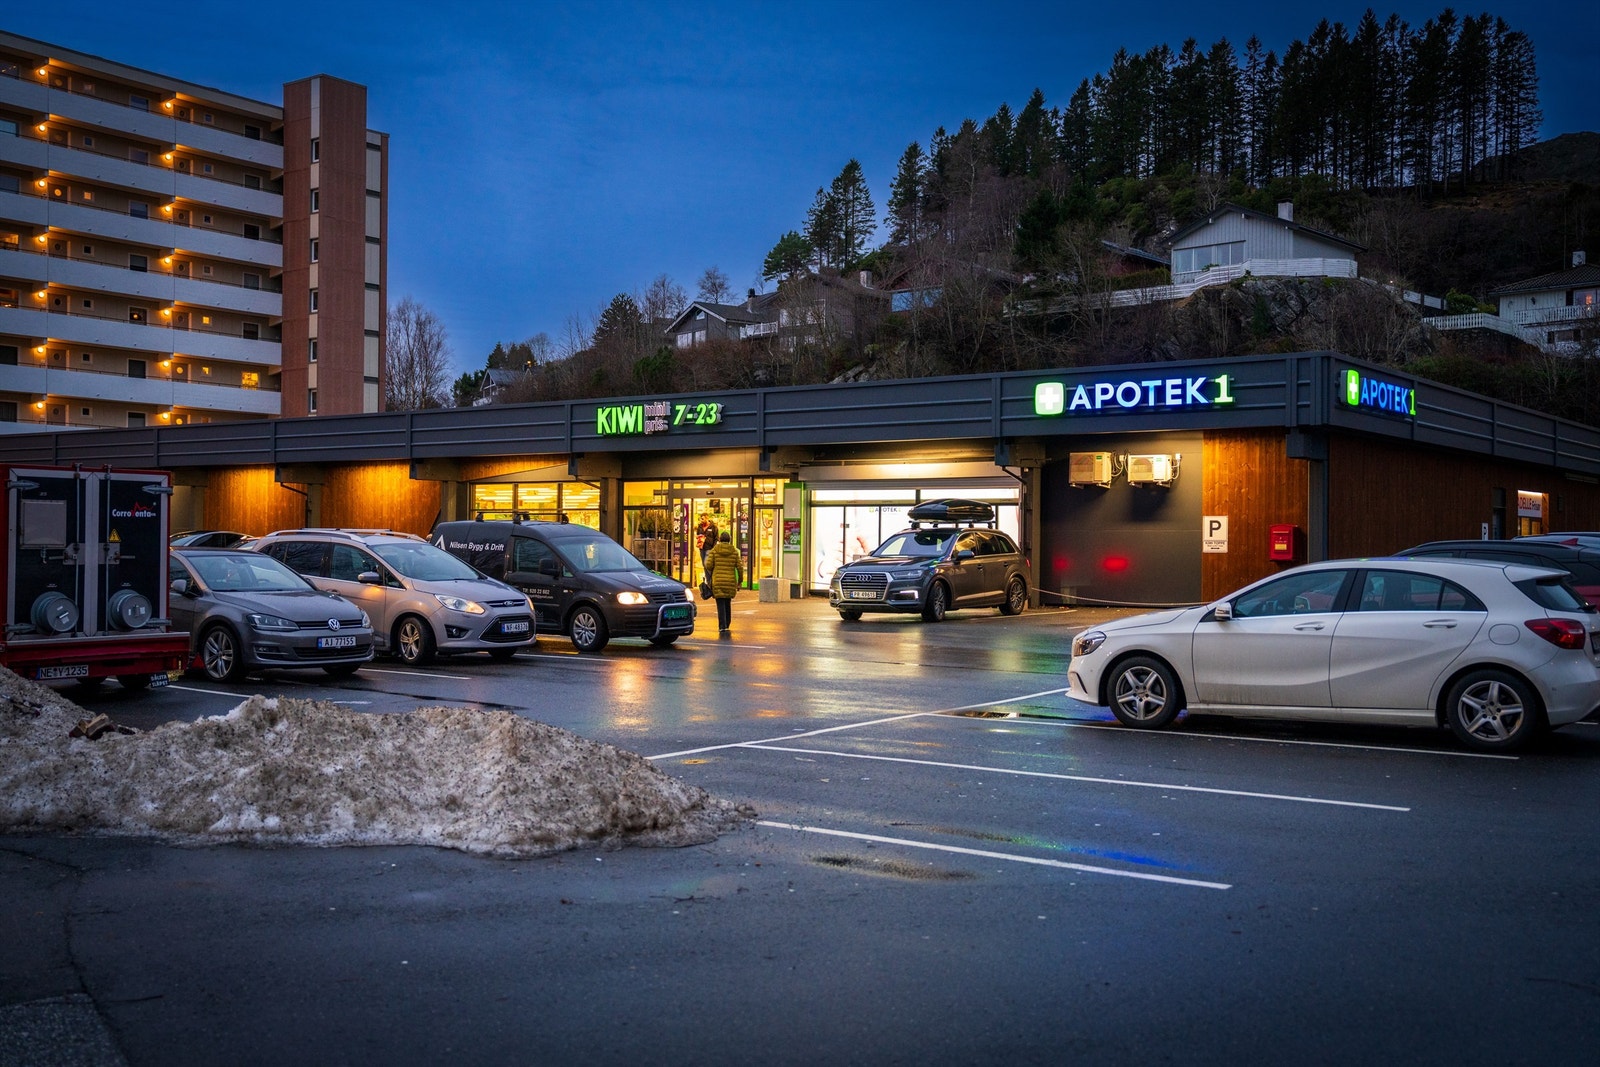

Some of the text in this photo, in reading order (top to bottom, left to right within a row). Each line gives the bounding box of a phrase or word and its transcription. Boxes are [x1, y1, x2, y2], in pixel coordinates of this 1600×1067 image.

[1069, 374, 1233, 410] APOTEK 1
[1361, 378, 1416, 415] APOTEK 1
[645, 402, 668, 417] mini
[597, 405, 643, 434] KIWI
[645, 417, 666, 434] pris
[1209, 520, 1221, 537] P
[449, 541, 468, 549] Nilsen
[468, 542, 483, 551] Bygg
[490, 543, 505, 551] Drift
[335, 637, 353, 646] 77155
[40, 668, 51, 678] NE
[66, 665, 88, 676] 1235
